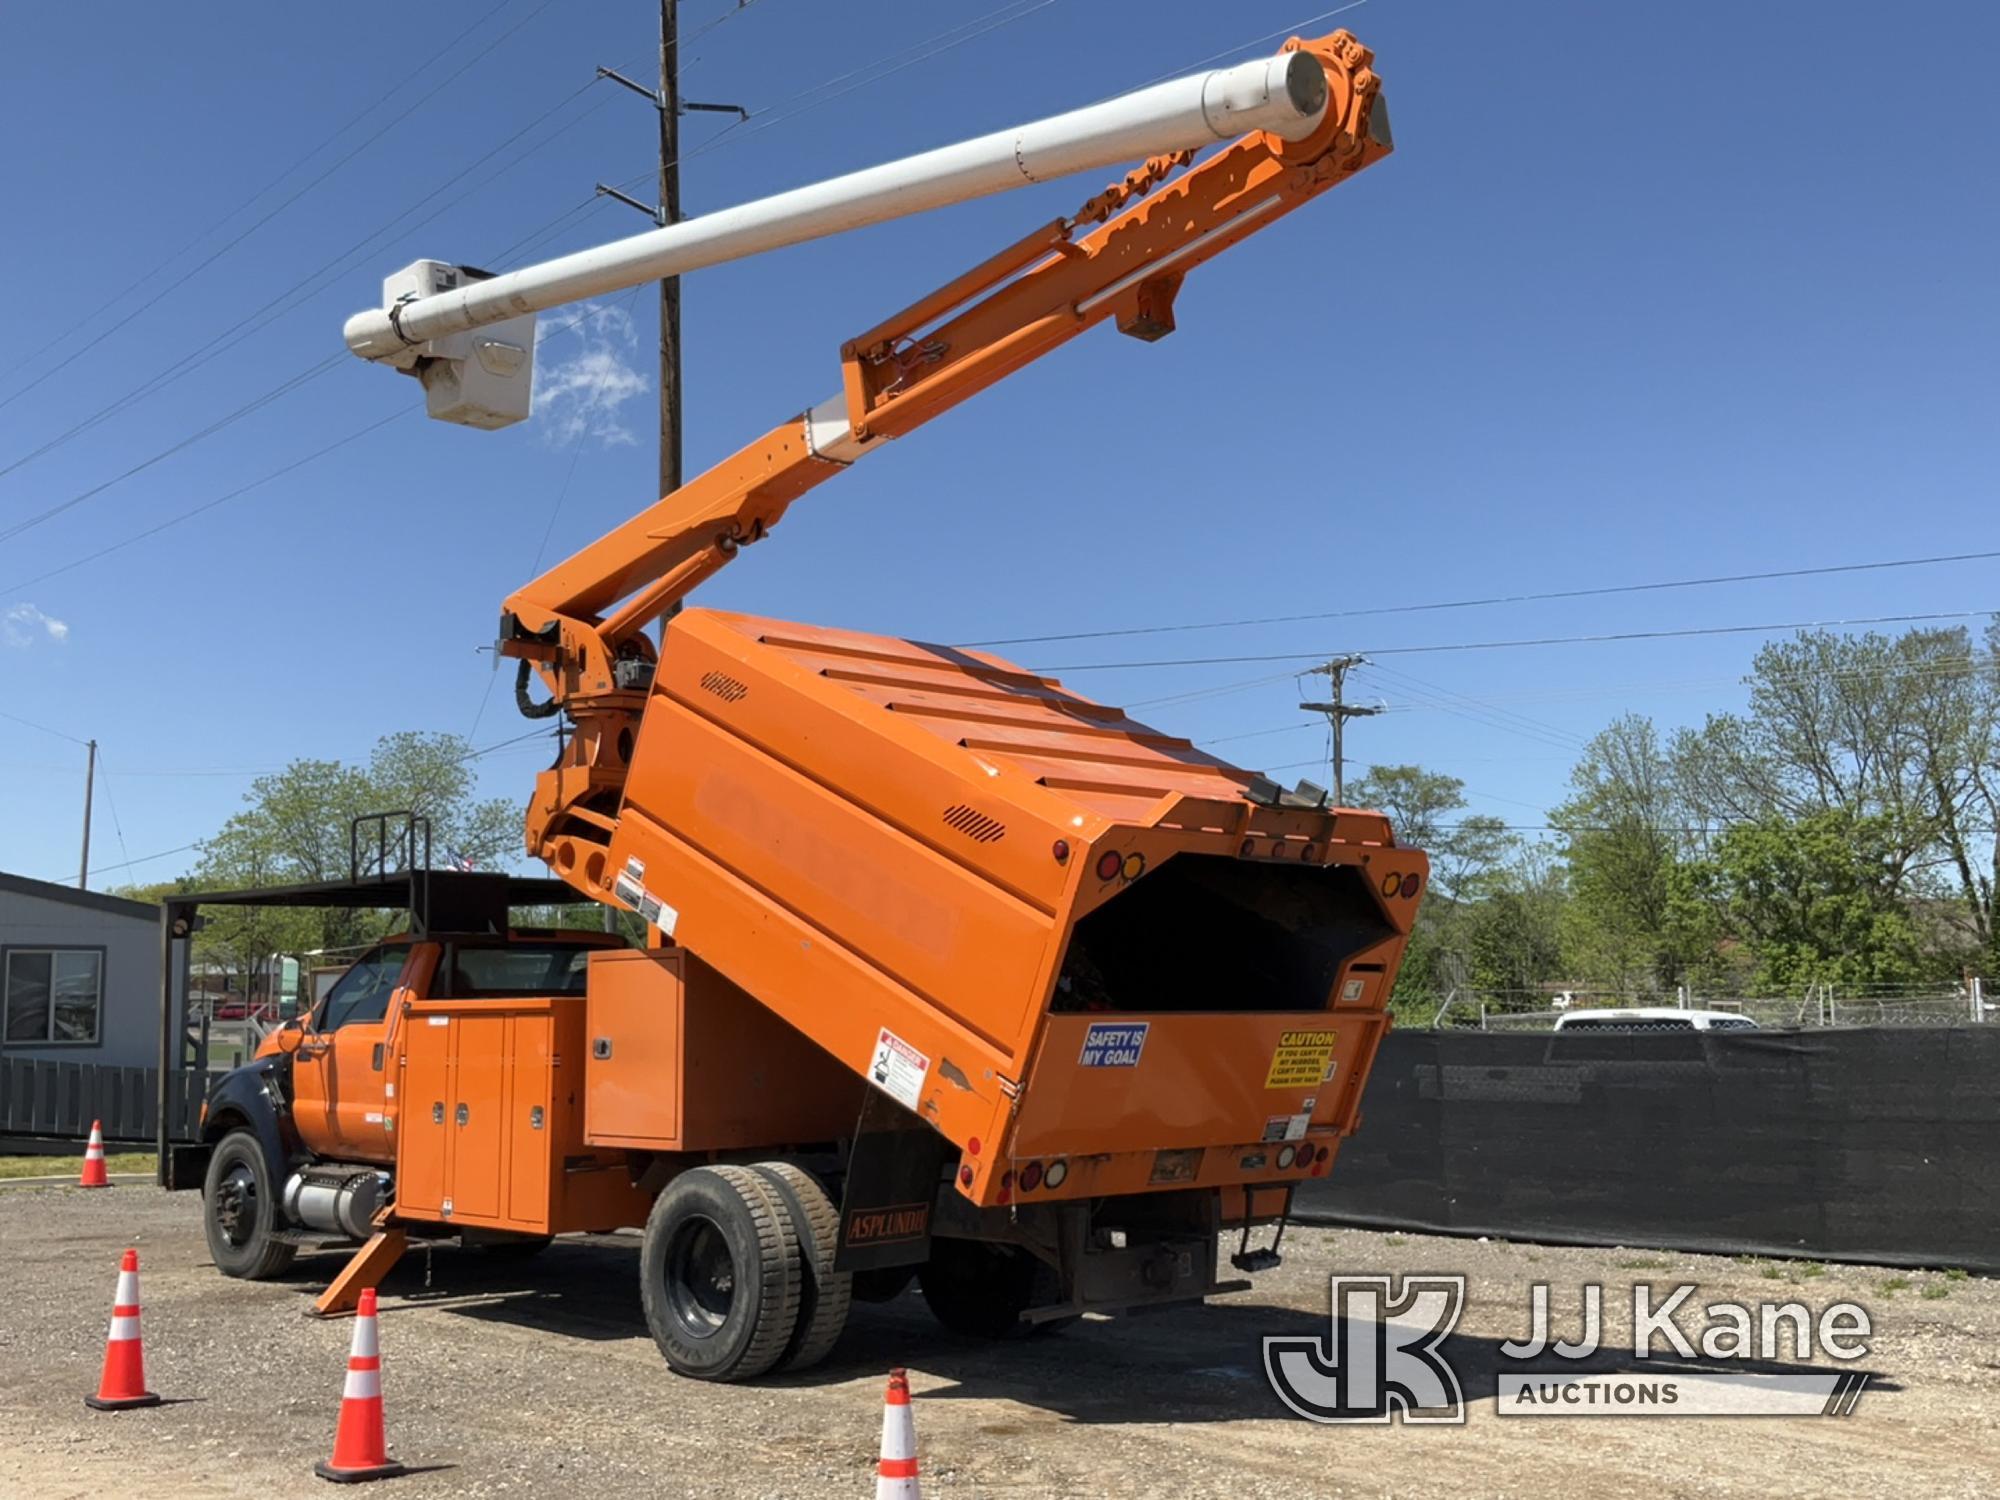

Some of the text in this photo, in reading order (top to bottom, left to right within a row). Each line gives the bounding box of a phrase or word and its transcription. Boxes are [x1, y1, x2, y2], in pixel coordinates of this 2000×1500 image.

[1088, 1031, 1144, 1047] SAFETY IS
[1280, 1032, 1335, 1046] CAUTION
[1082, 1050, 1136, 1065] MY GOAL
